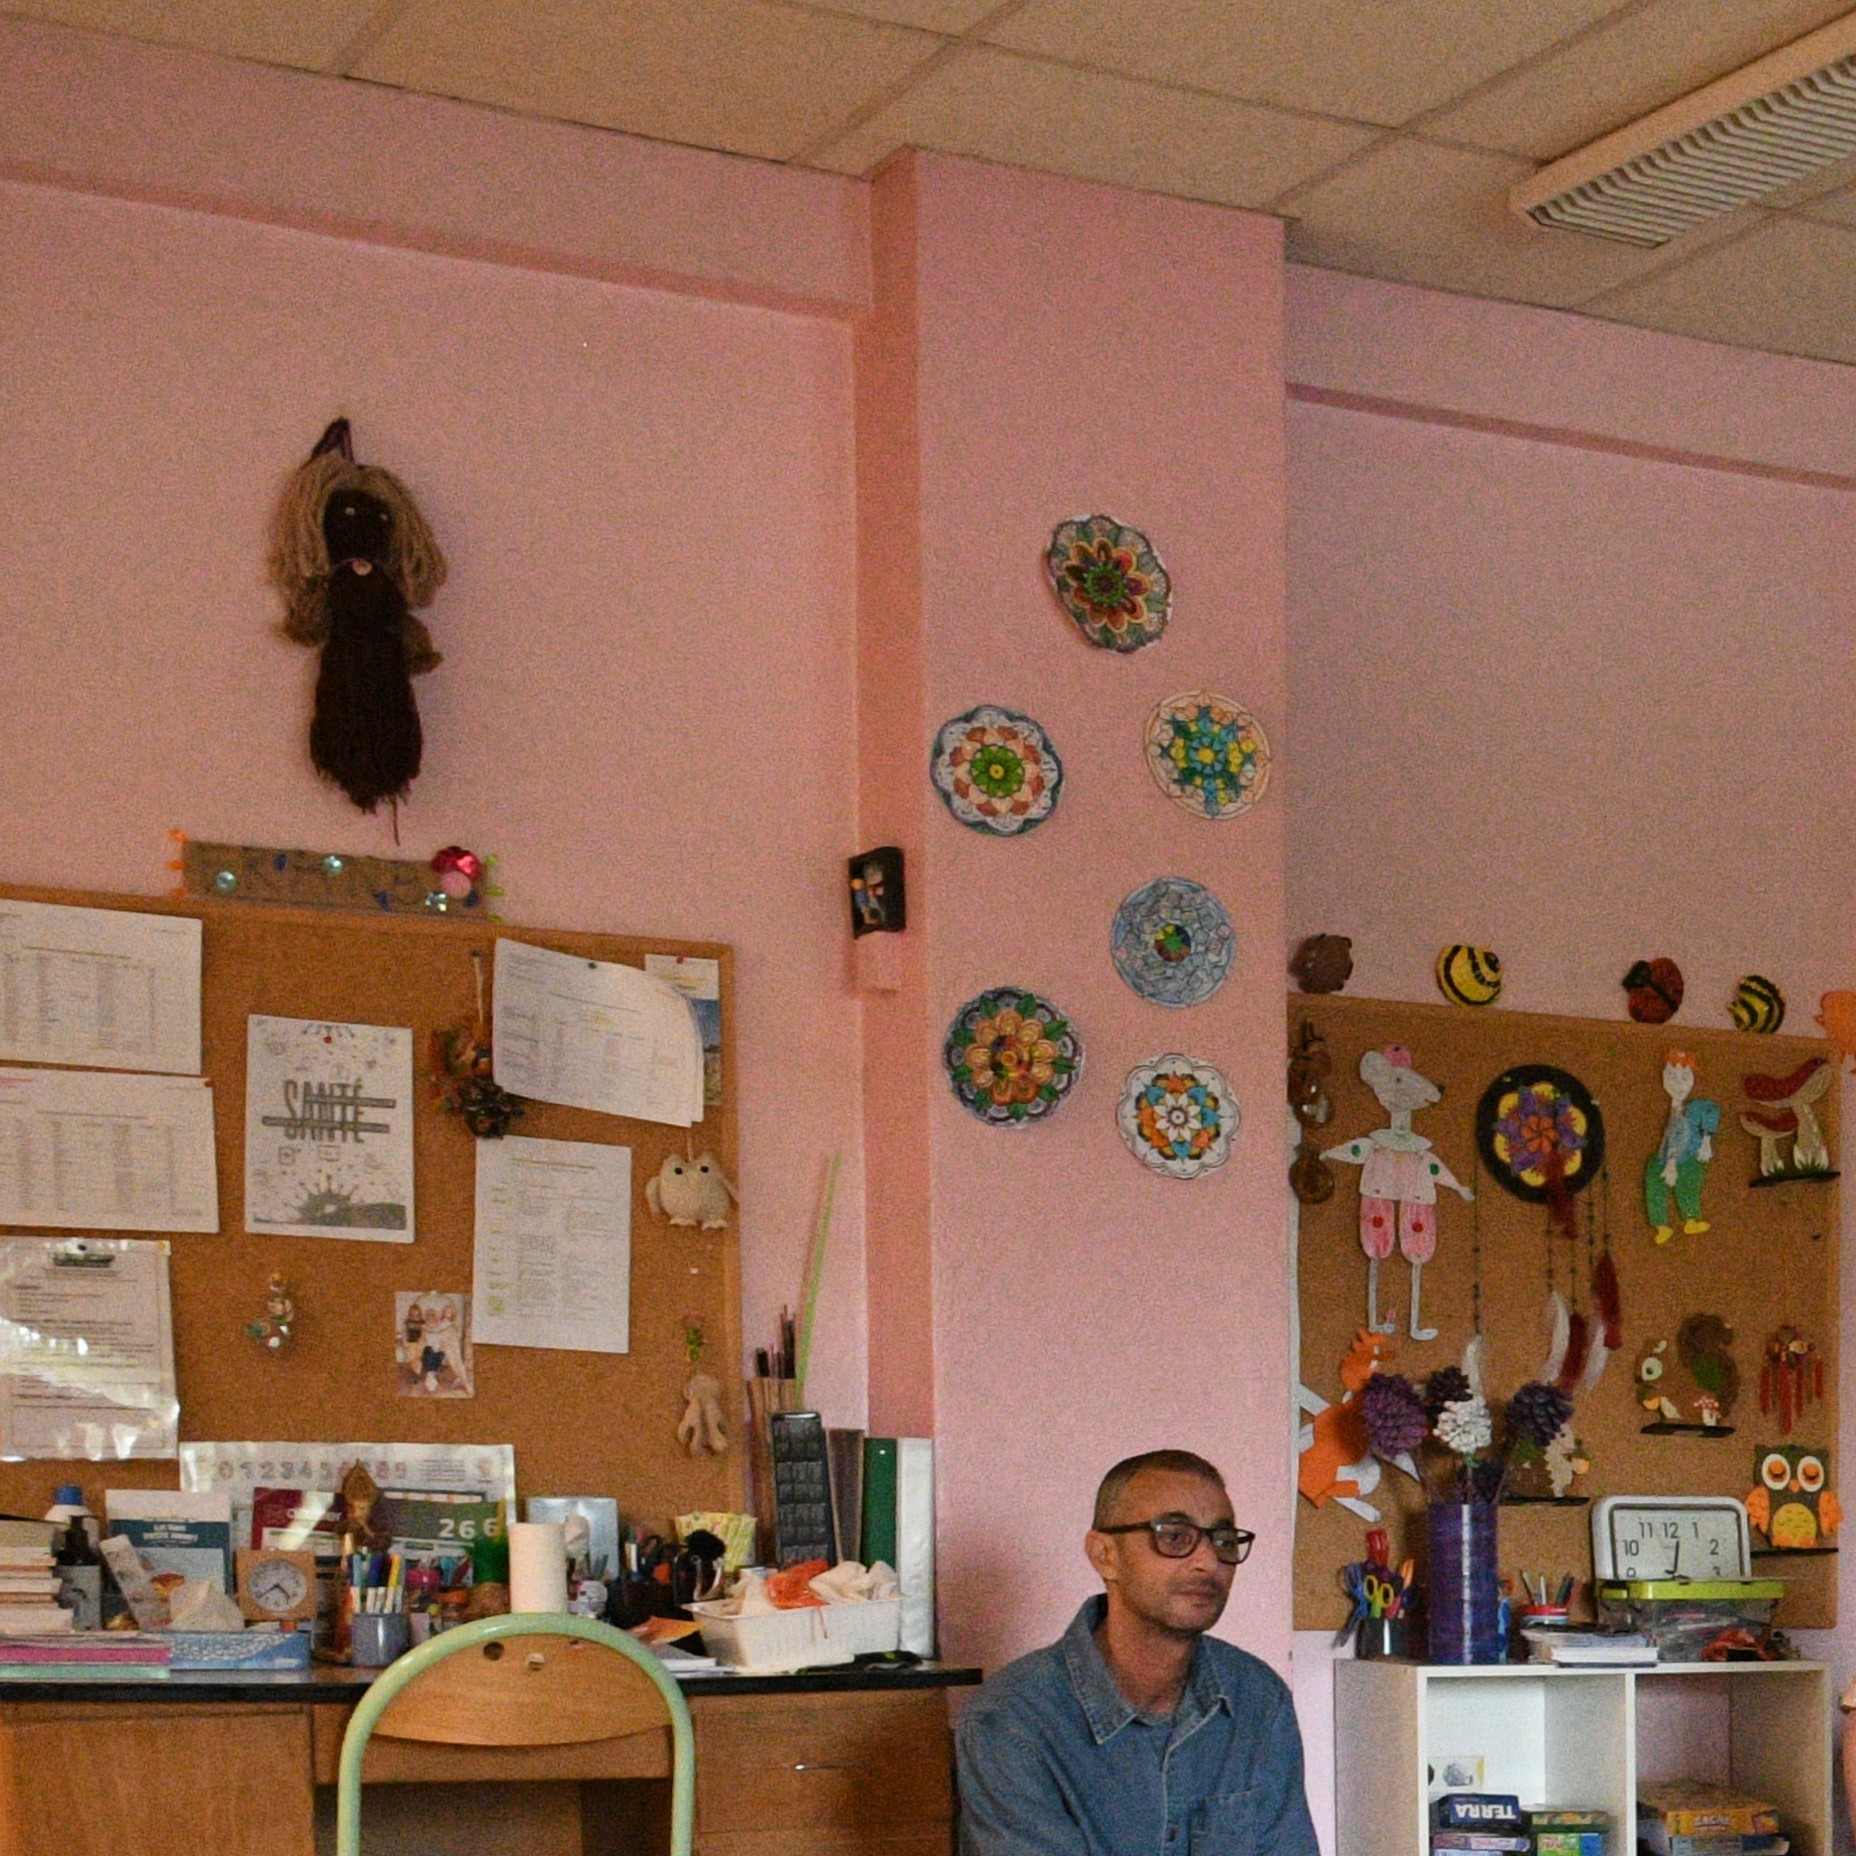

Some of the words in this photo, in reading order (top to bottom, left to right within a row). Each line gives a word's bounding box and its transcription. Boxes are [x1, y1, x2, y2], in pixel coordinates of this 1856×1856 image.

[1639, 1522, 1653, 1538] 11
[1663, 1522, 1679, 1538] 12
[1692, 1522, 1699, 1538] 1
[1623, 1540, 1640, 1556] 10
[1709, 1539, 1719, 1555] 2
[1454, 1804, 1517, 1819] TERRA
